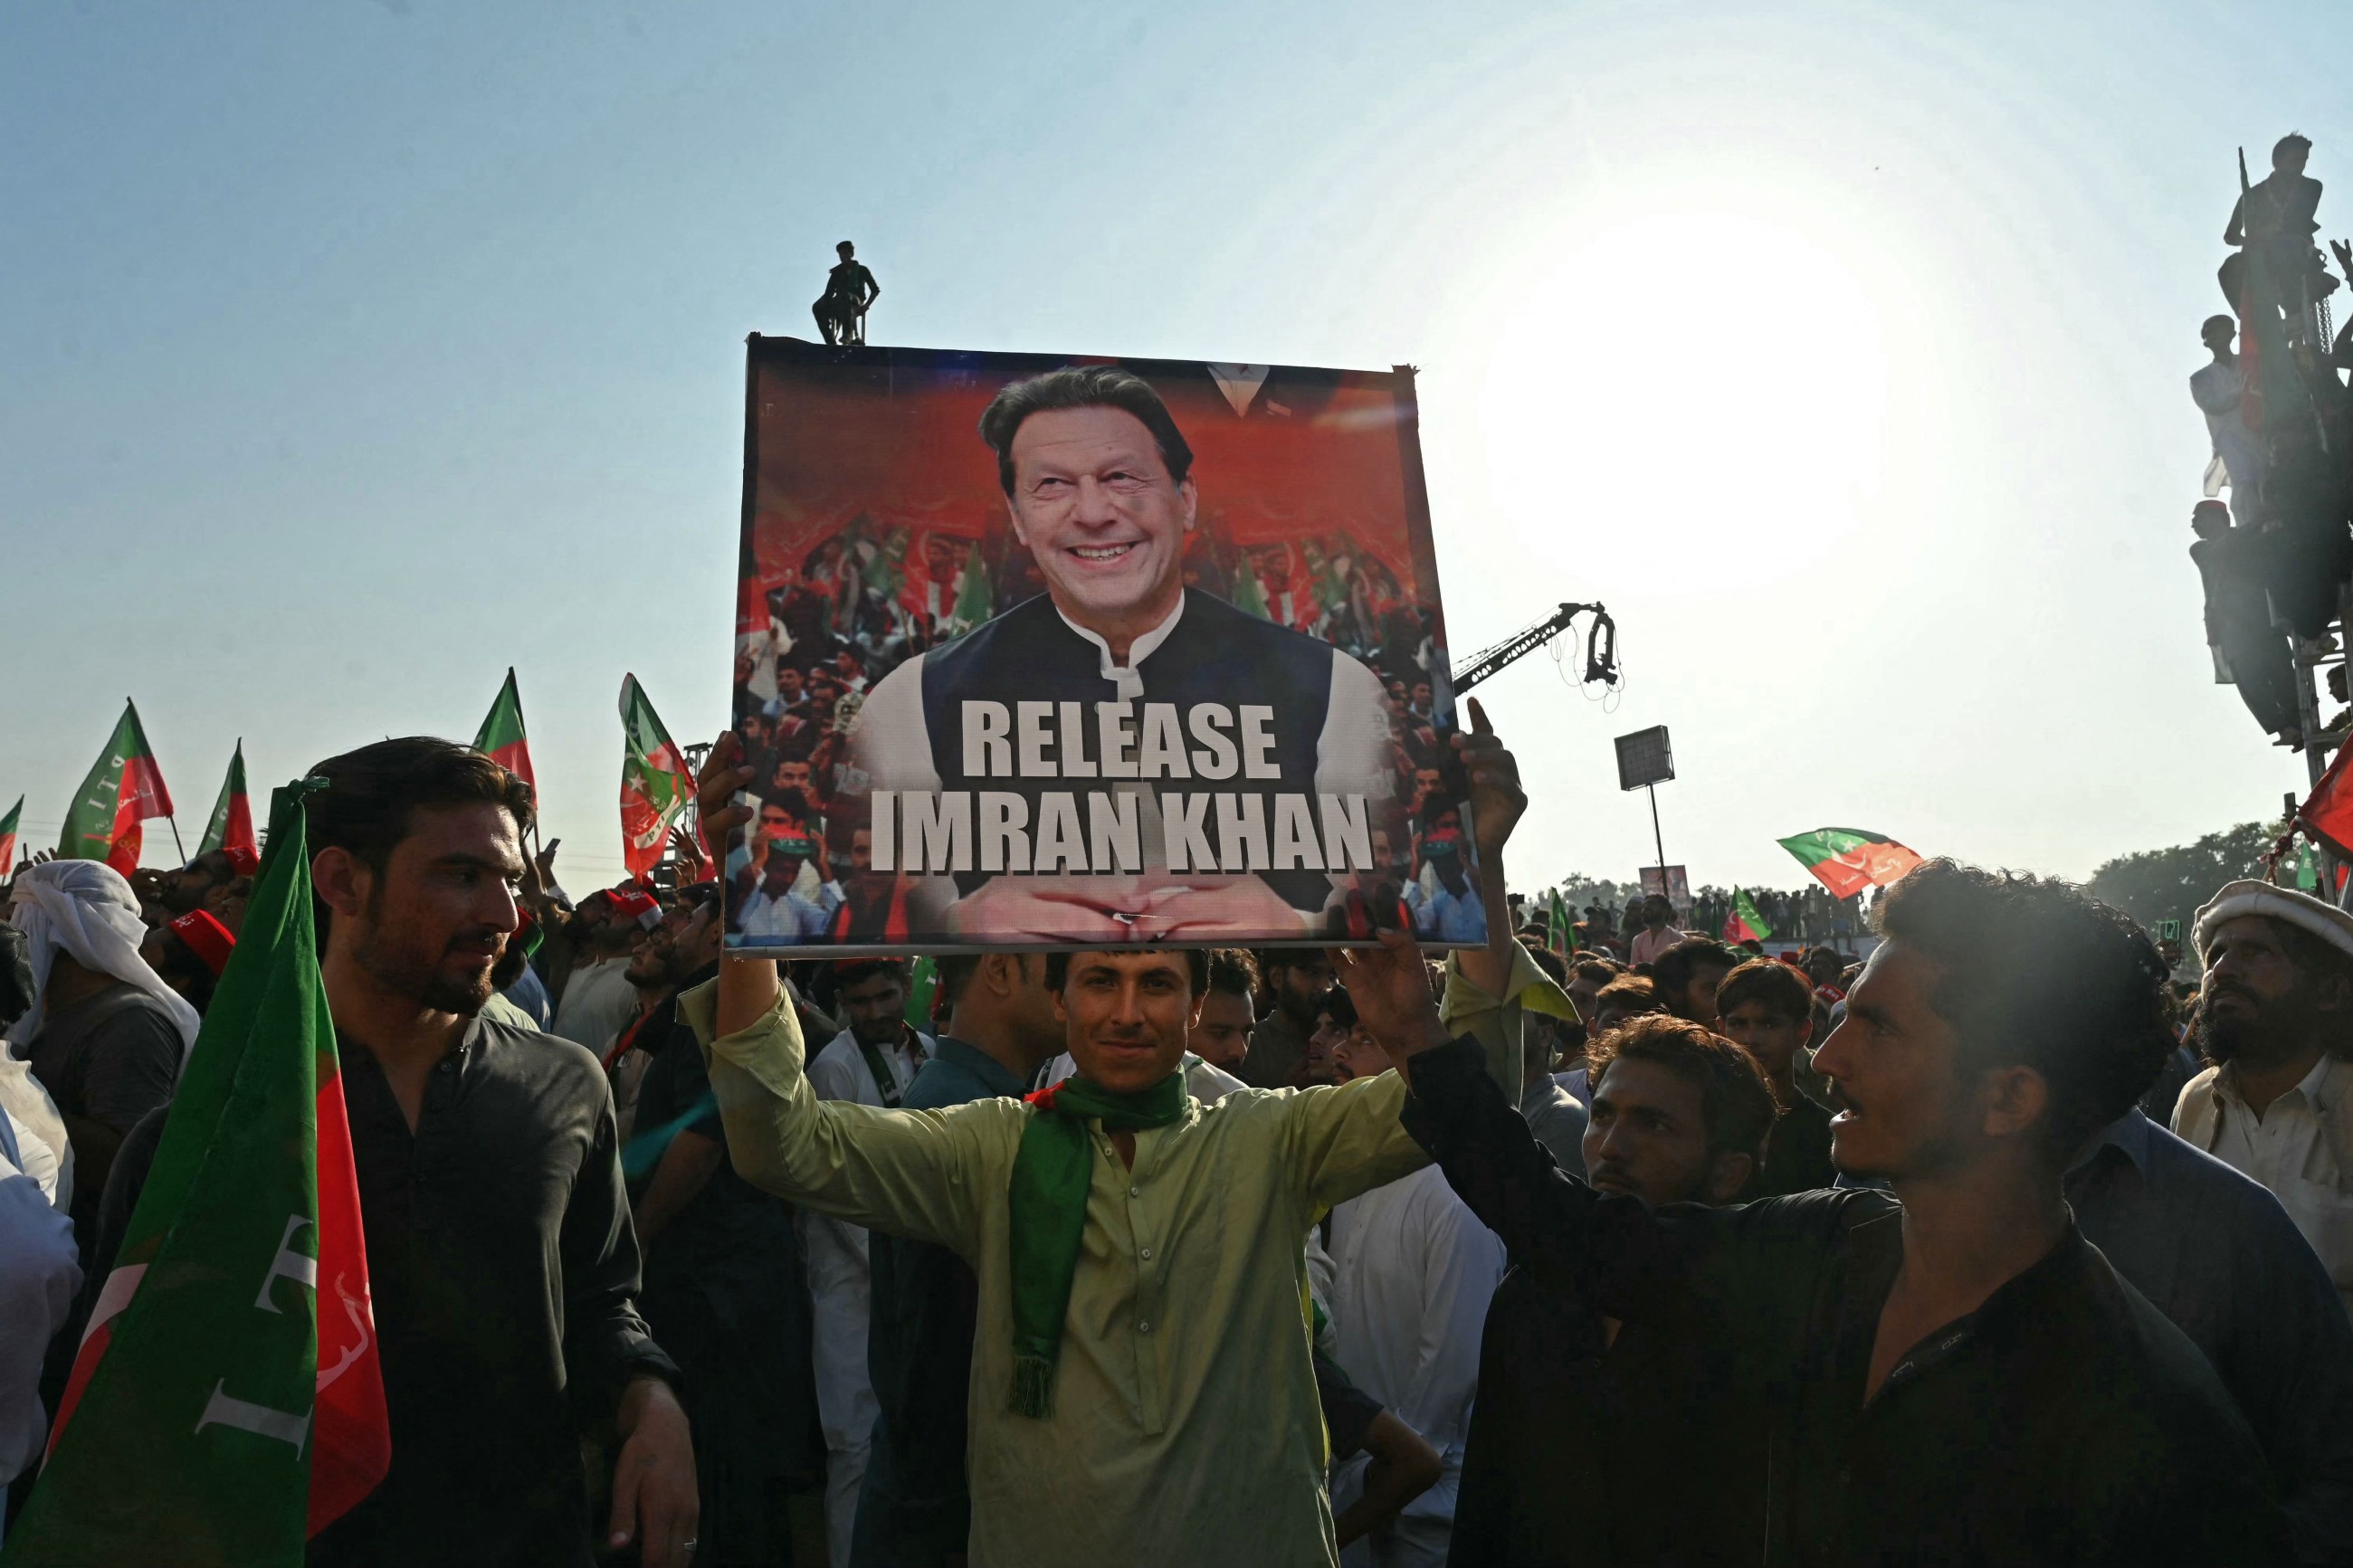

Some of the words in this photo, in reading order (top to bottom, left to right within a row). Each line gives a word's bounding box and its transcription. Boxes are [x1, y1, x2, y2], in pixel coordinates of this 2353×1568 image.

[961, 699, 1281, 780] RELEASE
[647, 814, 665, 842] PTI
[871, 790, 1141, 871] IMRAN
[1161, 793, 1373, 870] KHAN
